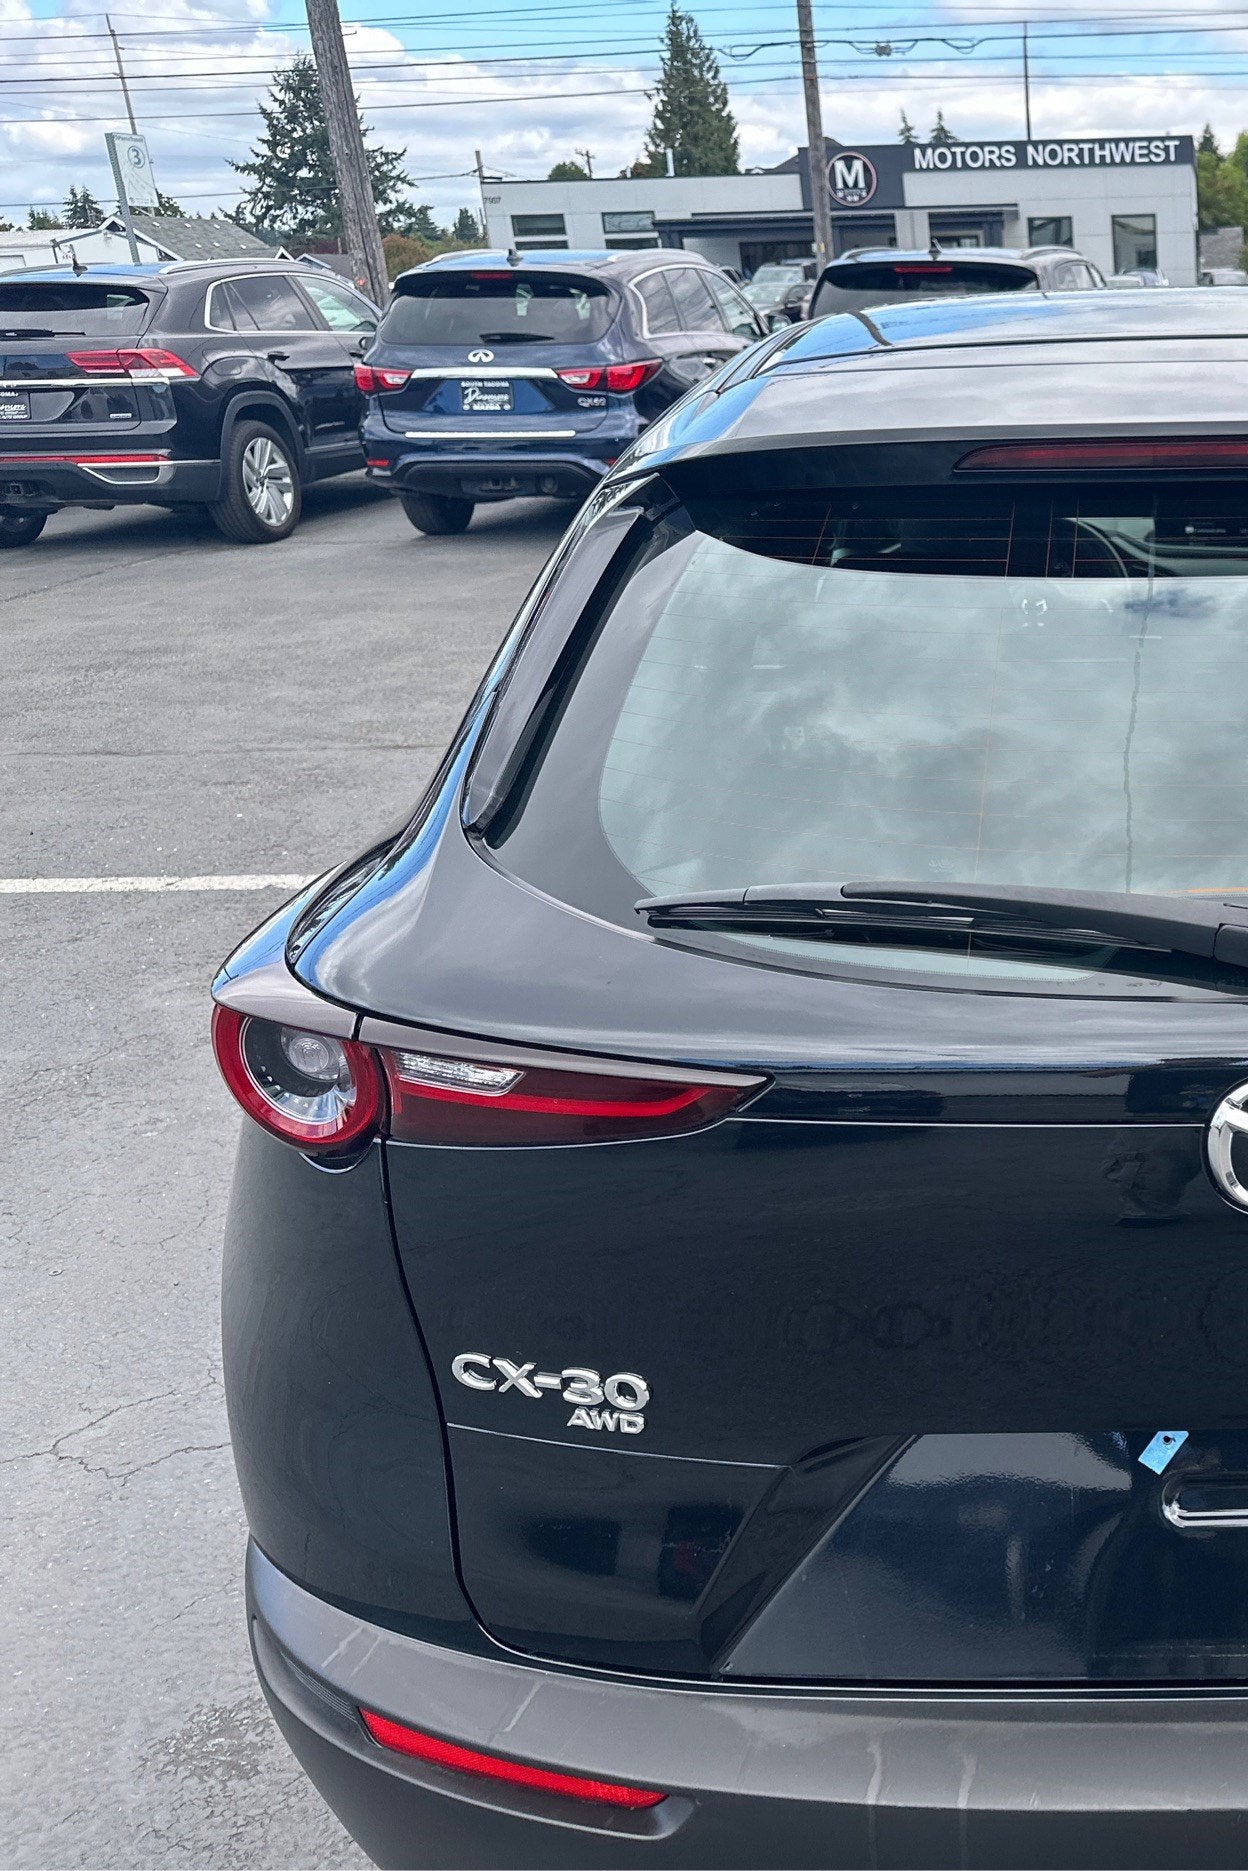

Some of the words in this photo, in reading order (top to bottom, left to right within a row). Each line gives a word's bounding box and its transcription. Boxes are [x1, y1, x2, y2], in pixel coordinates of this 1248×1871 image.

[131, 148, 142, 166] 3
[914, 145, 1017, 170] MOTORS
[1027, 140, 1180, 167] NORTHWEST
[834, 159, 866, 189] M
[452, 1352, 650, 1411] CX-30
[567, 1406, 645, 1434] AWD
